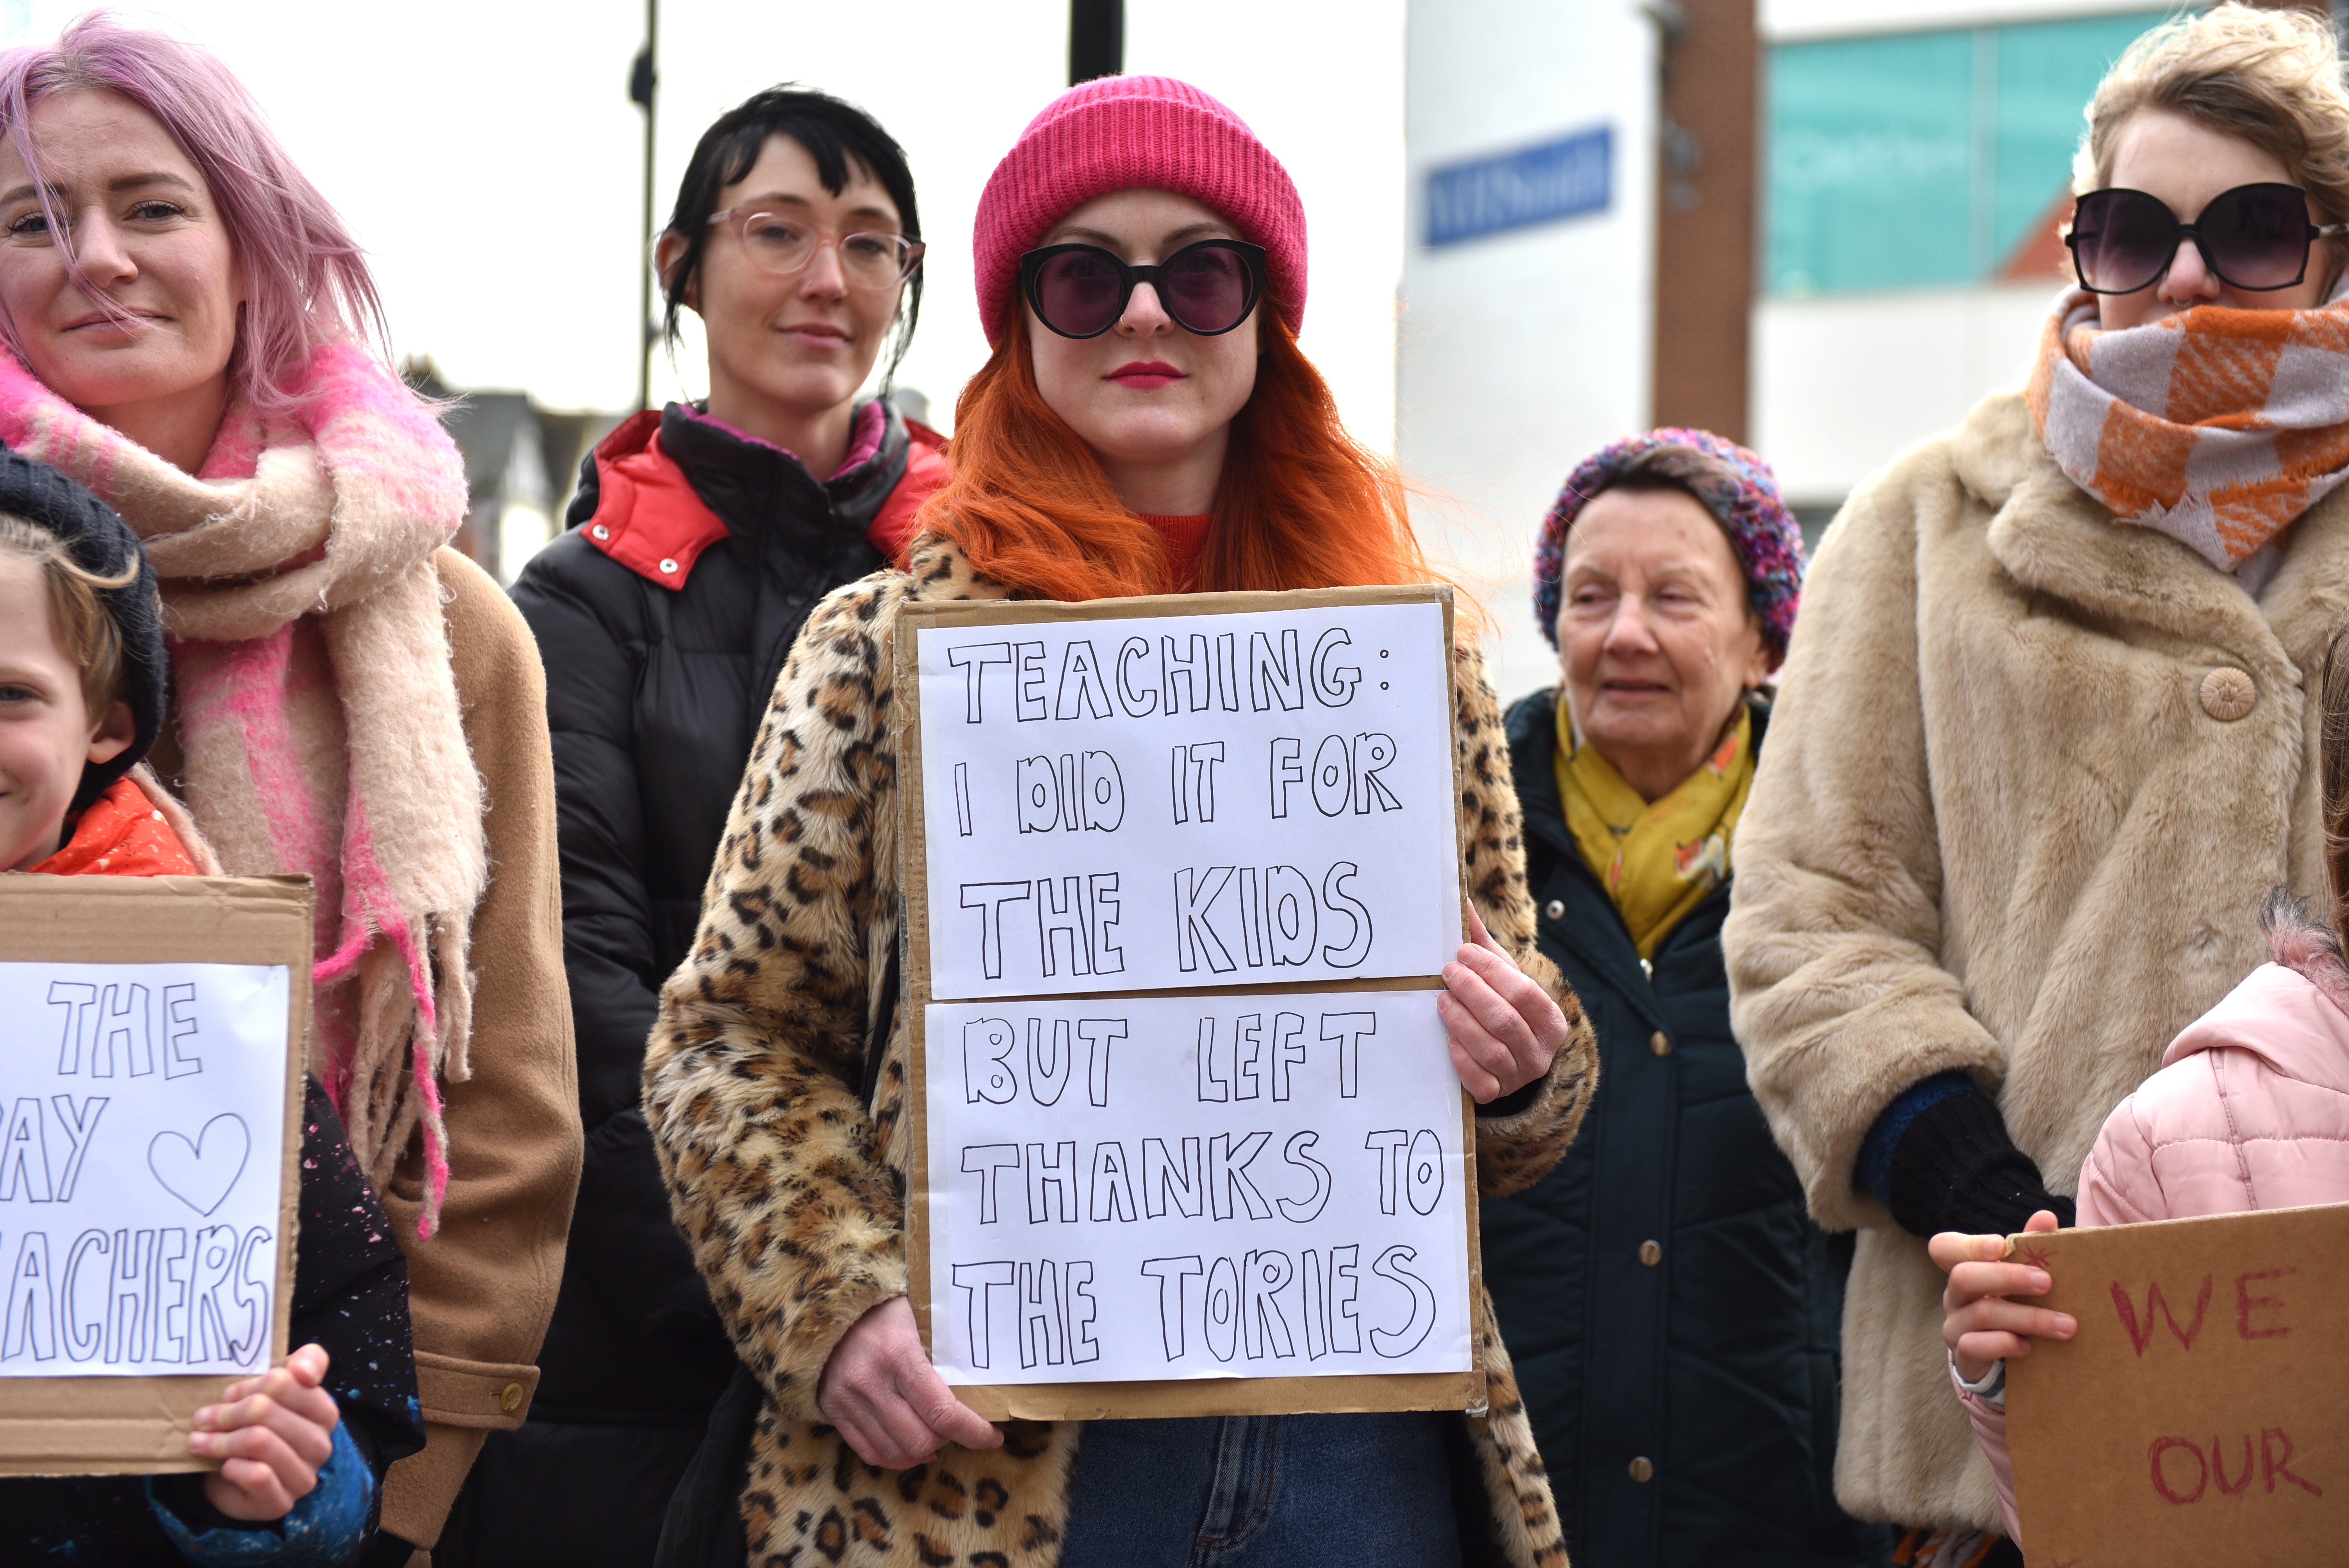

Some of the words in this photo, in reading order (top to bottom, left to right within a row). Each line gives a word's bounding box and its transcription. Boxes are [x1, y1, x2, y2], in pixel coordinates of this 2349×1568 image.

[947, 627, 1389, 724] TEACHING:
[955, 762, 972, 837] I
[1016, 750, 1125, 834] DID
[1172, 741, 1224, 825] IT
[1270, 732, 1403, 819] FOR
[960, 872, 1125, 980] THE
[1174, 861, 1372, 974] KIDS
[48, 981, 203, 1080] THE
[964, 1017, 1128, 1108] BUT
[1198, 1012, 1376, 1103] LEFT
[0, 1094, 109, 1203] AY
[961, 1130, 1331, 1225] THANKS
[1365, 1129, 1444, 1216] TO
[0, 1225, 272, 1366] ACHERS
[952, 1259, 1099, 1370] THE
[1141, 1244, 1436, 1362] TORIES
[2110, 1267, 2297, 1358] WE
[2148, 1427, 2323, 1505] OUR
